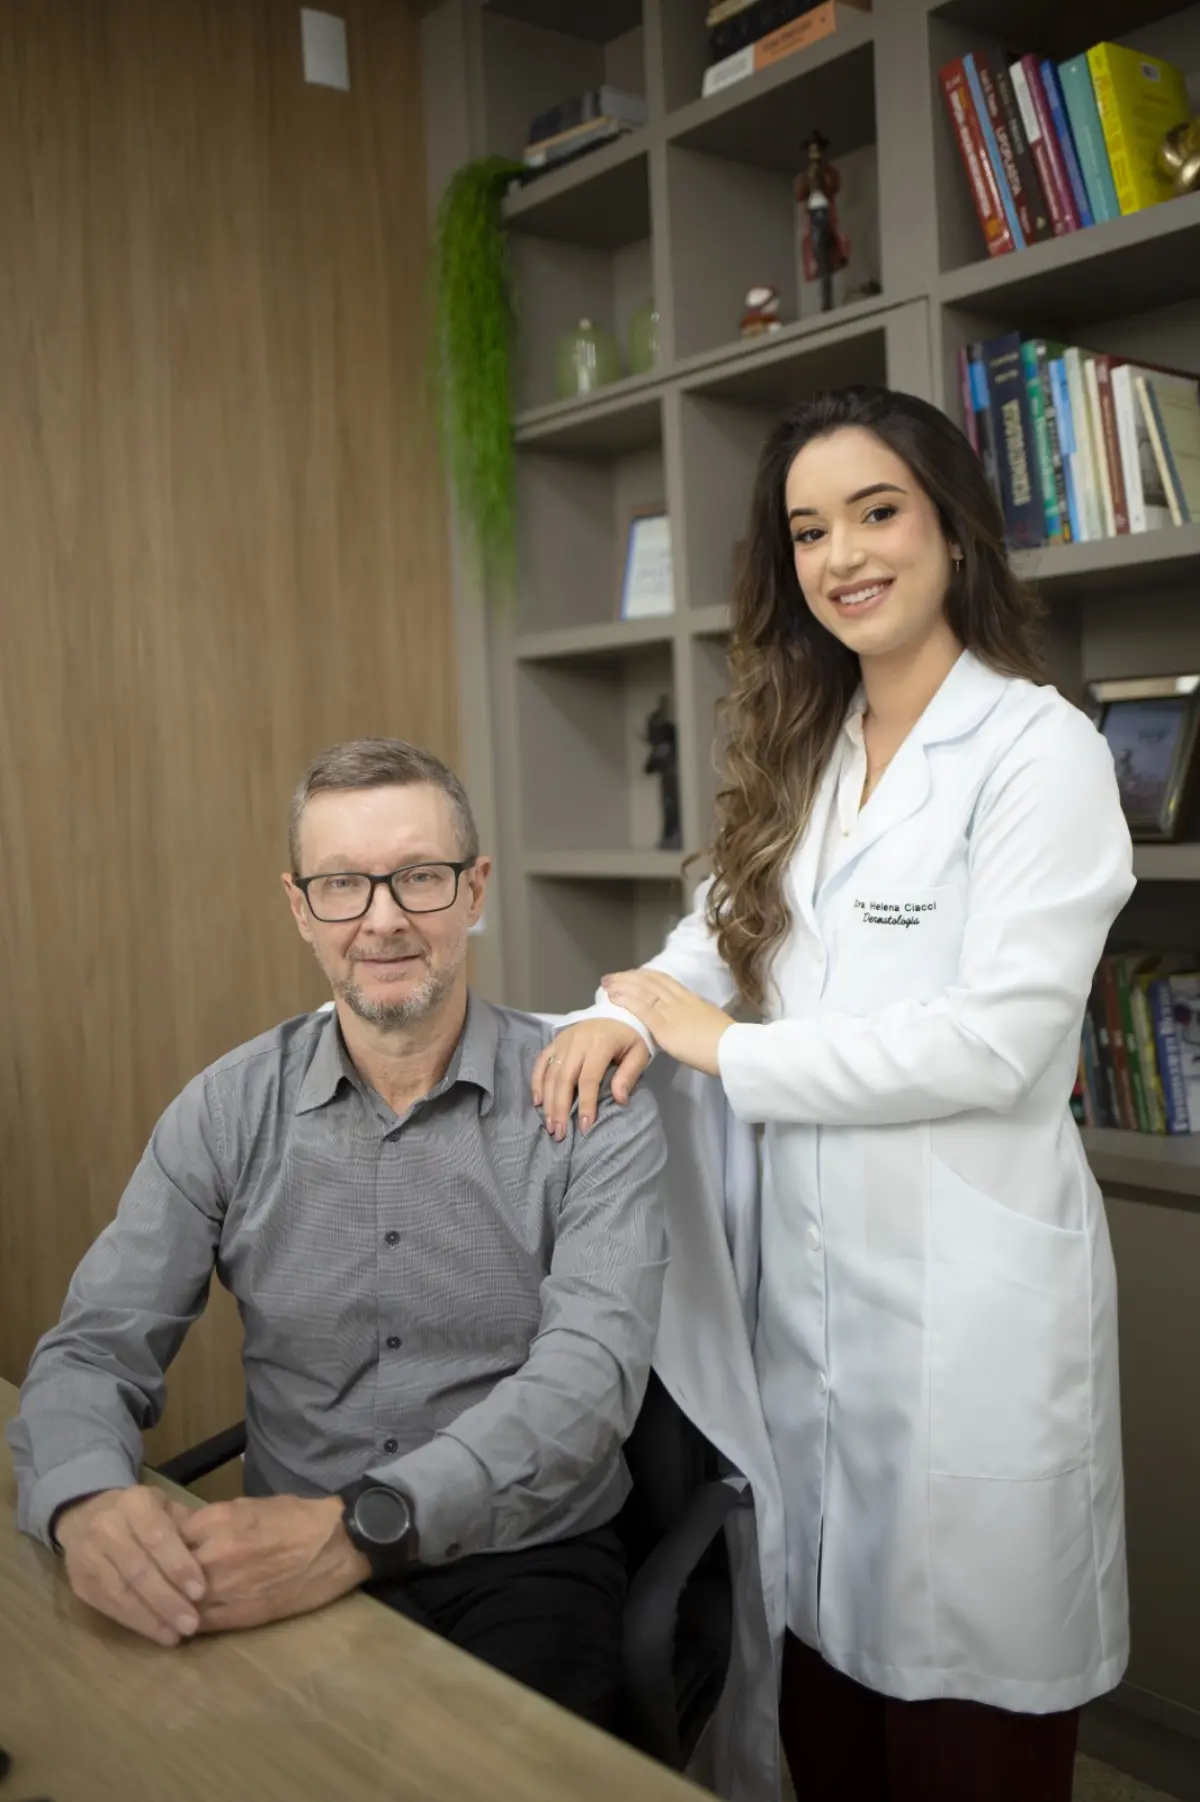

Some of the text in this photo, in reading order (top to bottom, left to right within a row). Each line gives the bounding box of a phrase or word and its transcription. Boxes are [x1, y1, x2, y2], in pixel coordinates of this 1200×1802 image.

[870, 901, 900, 911] Helena
[904, 901, 937, 911] Ciacci
[862, 912, 920, 928] Dermatologia
